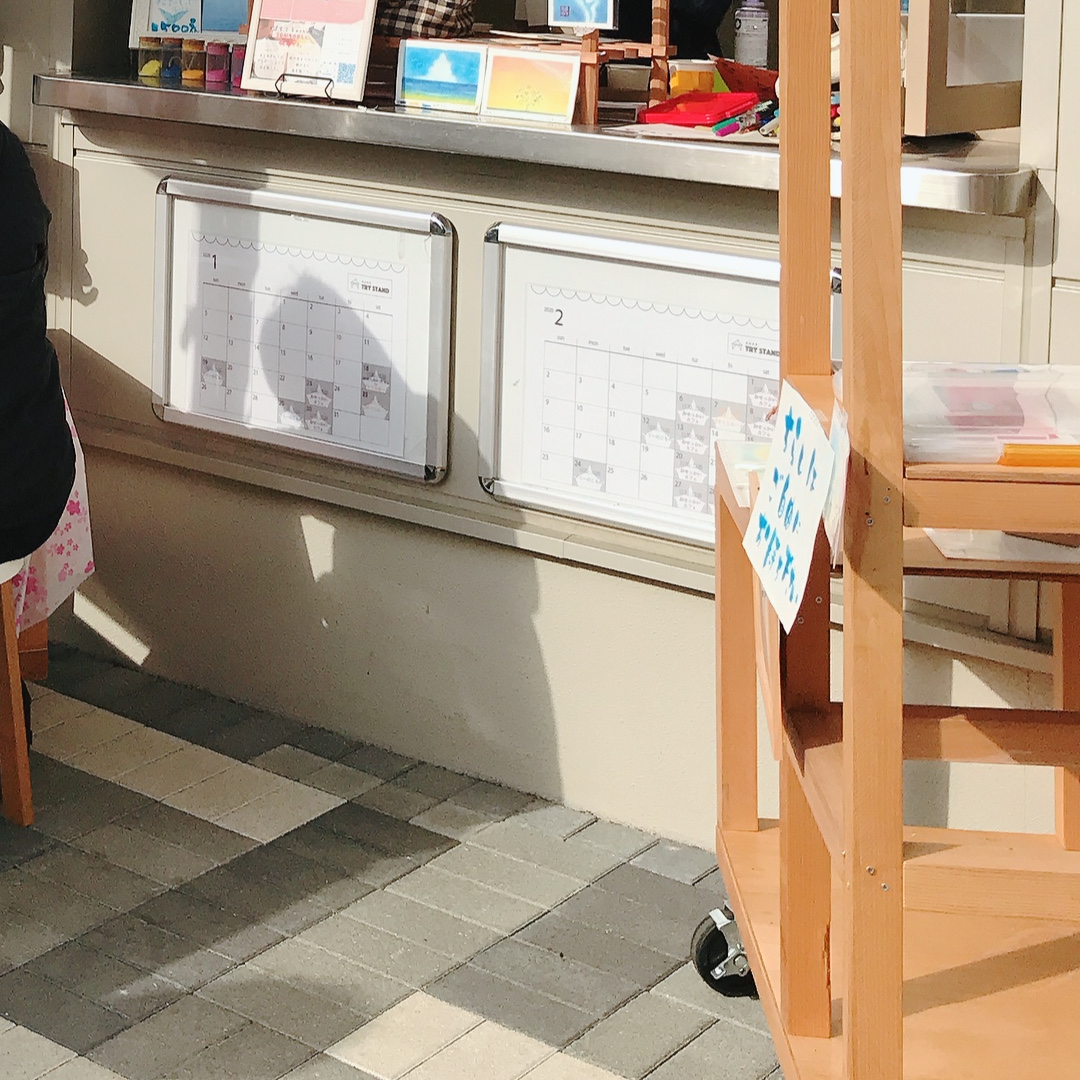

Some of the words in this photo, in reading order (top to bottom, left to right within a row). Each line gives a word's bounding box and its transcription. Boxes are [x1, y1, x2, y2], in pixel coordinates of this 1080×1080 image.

[212, 254, 217, 270] 1
[361, 283, 372, 291] TRY
[372, 285, 390, 294] STAND
[554, 309, 563, 326] 2
[744, 345, 758, 354] TRY
